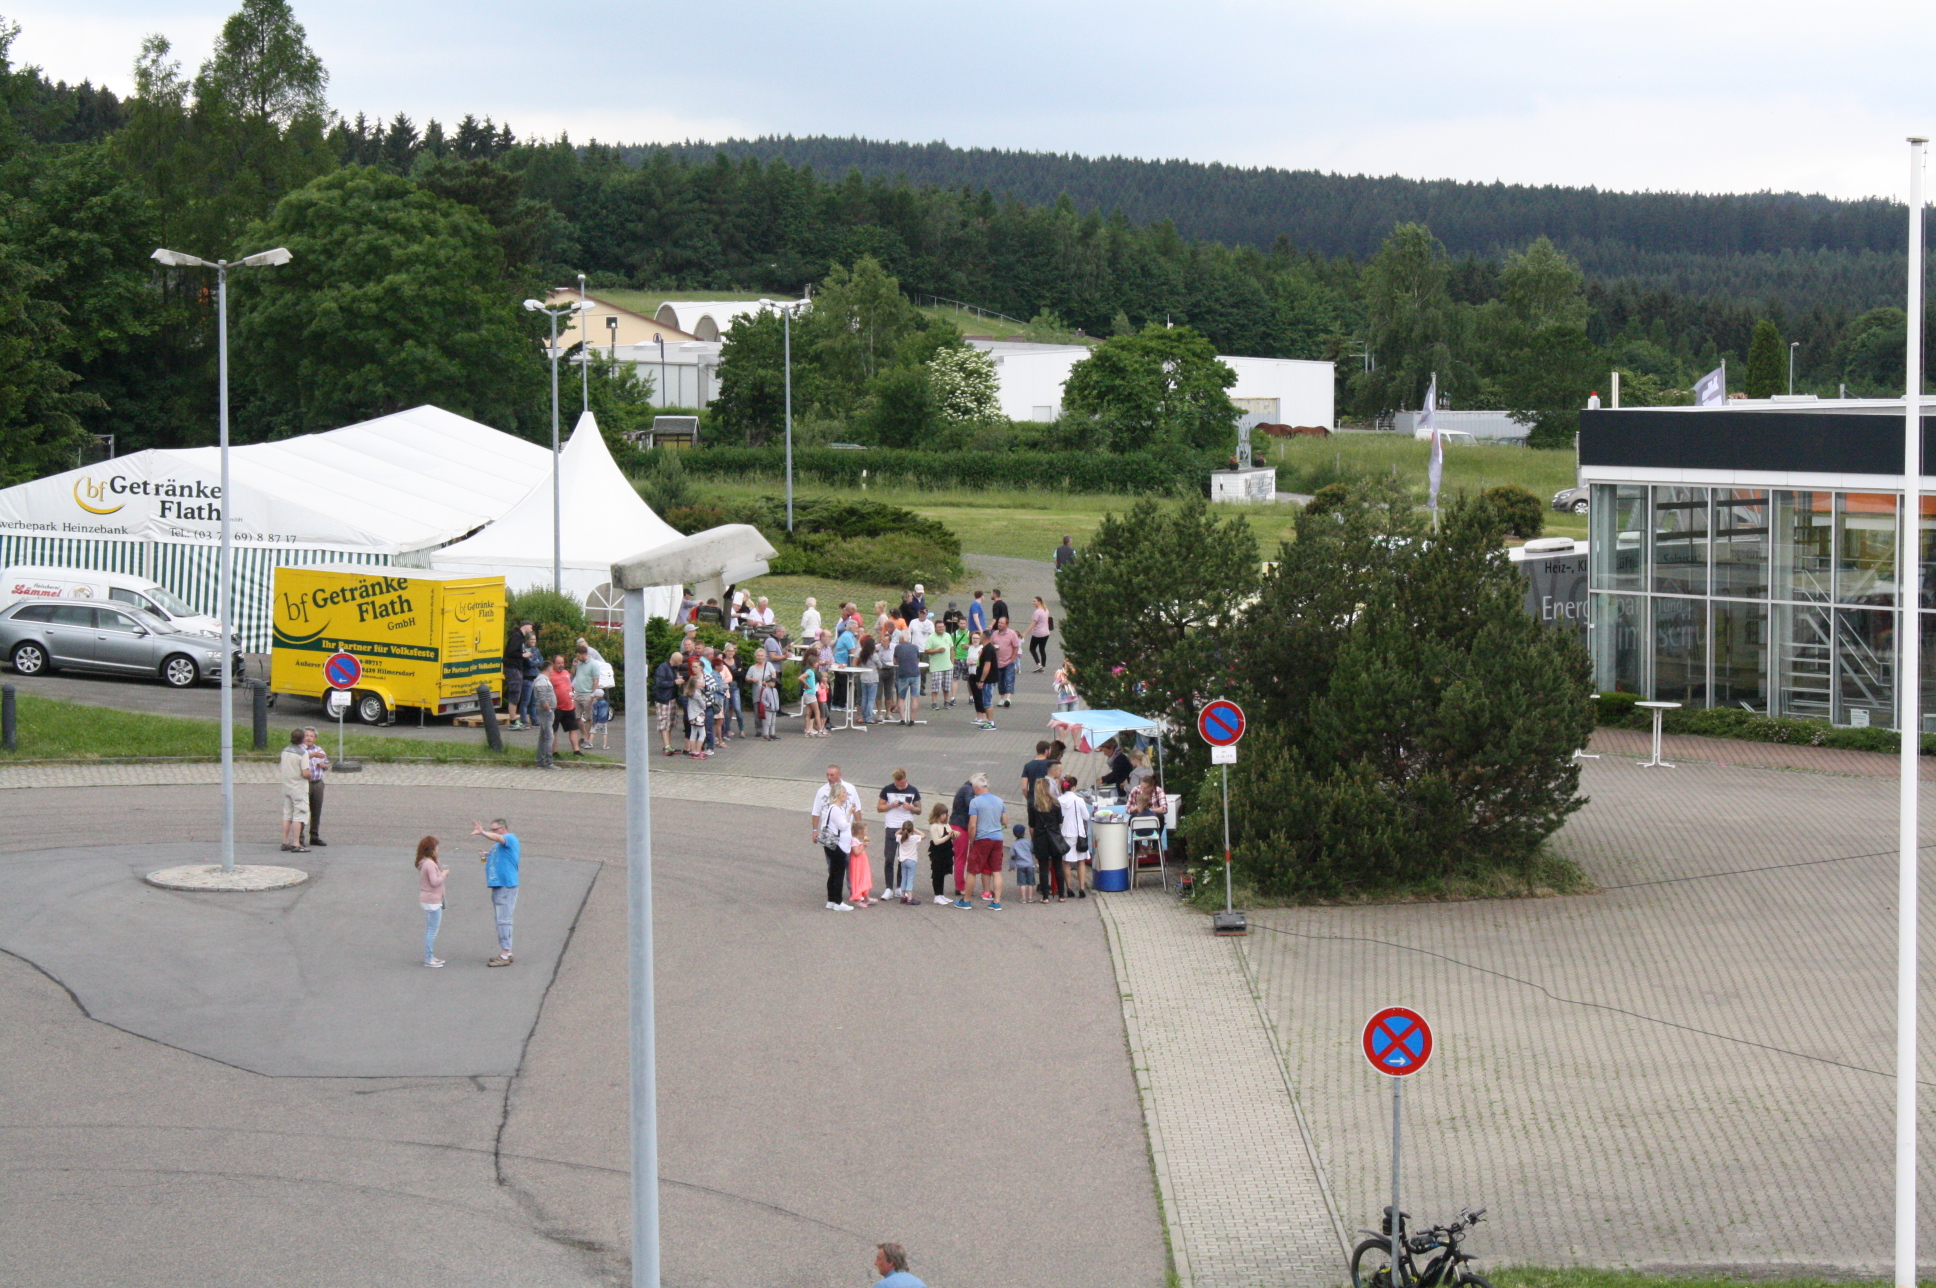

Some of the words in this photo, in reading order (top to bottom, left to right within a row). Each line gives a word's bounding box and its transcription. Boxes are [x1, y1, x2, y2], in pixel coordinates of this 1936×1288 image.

[86, 476, 108, 502] bf
[109, 475, 222, 500] Getränke
[159, 499, 222, 521] Flath
[0, 519, 58, 533] werbepark
[62, 522, 129, 535] Heinzebank
[234, 531, 253, 543] 69)
[267, 534, 281, 544] 87
[285, 534, 297, 545] 17
[1544, 561, 1575, 574] Heiz-,
[11, 584, 63, 598] Lämmel
[33, 582, 61, 591] Fleischerei
[283, 592, 310, 623] bf
[312, 574, 409, 609] Getränke
[356, 594, 414, 623] Flath
[479, 609, 495, 618] Flath
[387, 617, 416, 631] GmbH
[322, 640, 337, 649] Ihr
[338, 641, 372, 653] Partner
[374, 644, 389, 653] für
[390, 646, 436, 659] Volksfeste
